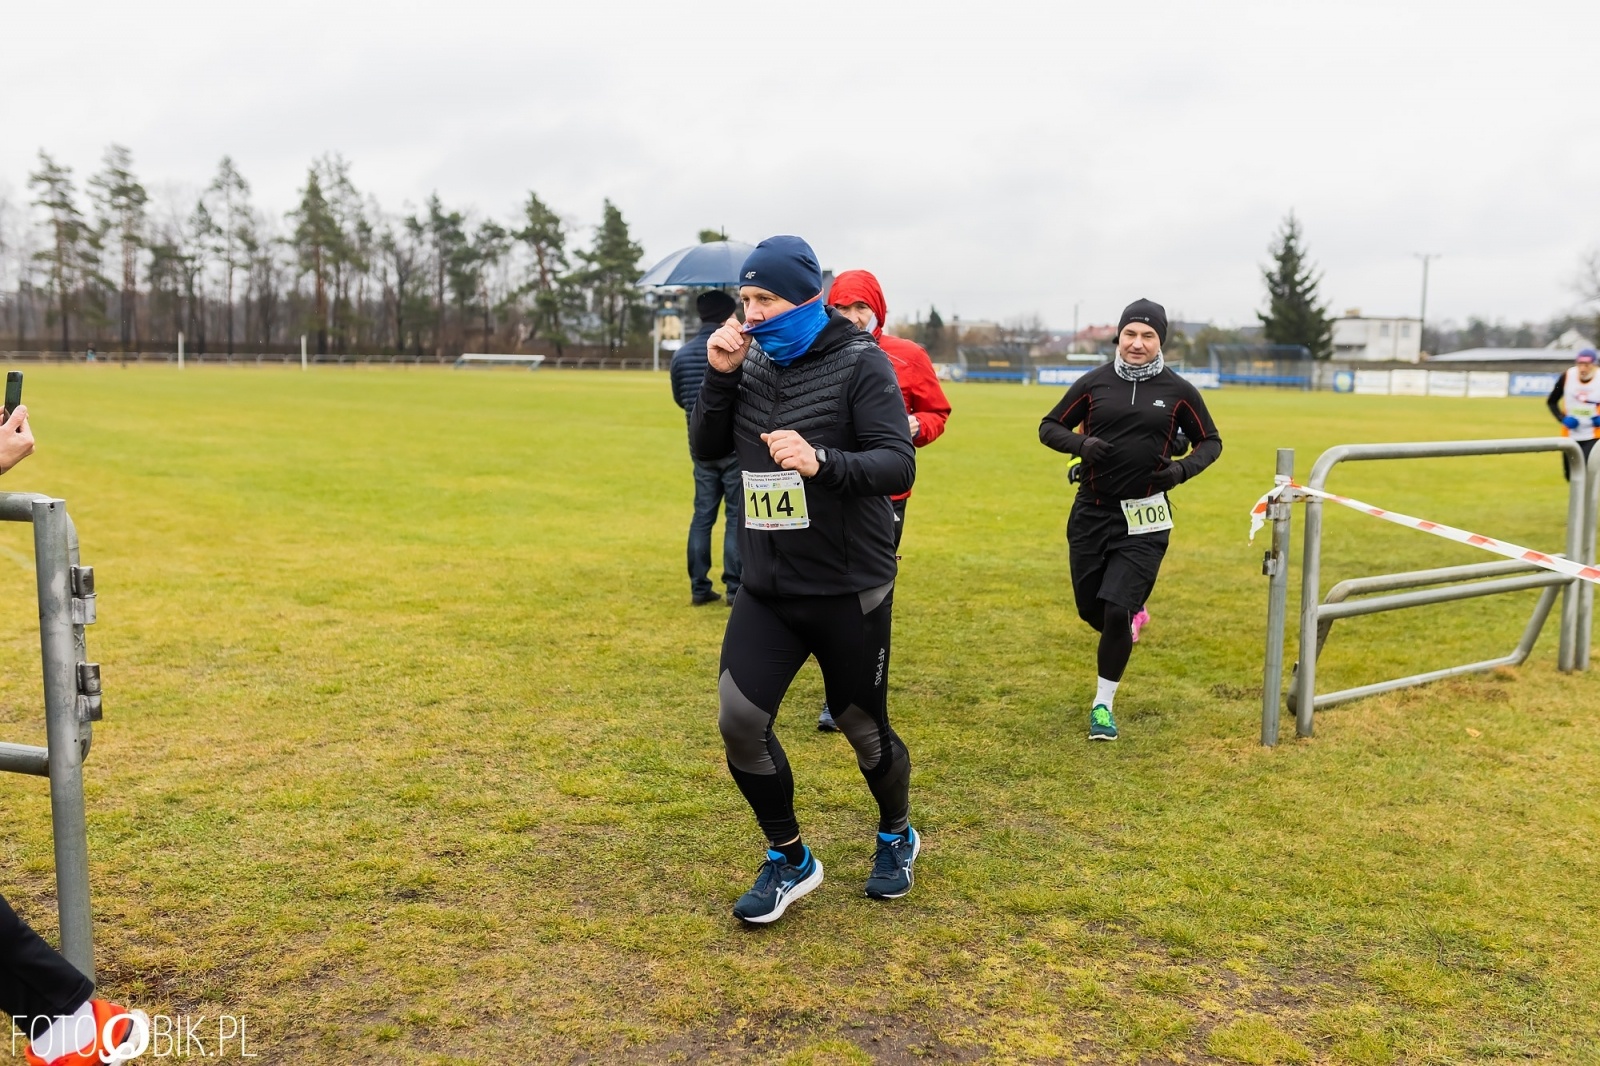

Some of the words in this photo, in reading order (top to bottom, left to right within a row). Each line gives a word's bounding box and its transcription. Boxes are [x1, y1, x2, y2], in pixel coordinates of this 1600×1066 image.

[745, 271, 757, 280] 4F
[884, 384, 896, 394] 4F
[750, 491, 794, 518] 114
[1134, 505, 1166, 525] 108
